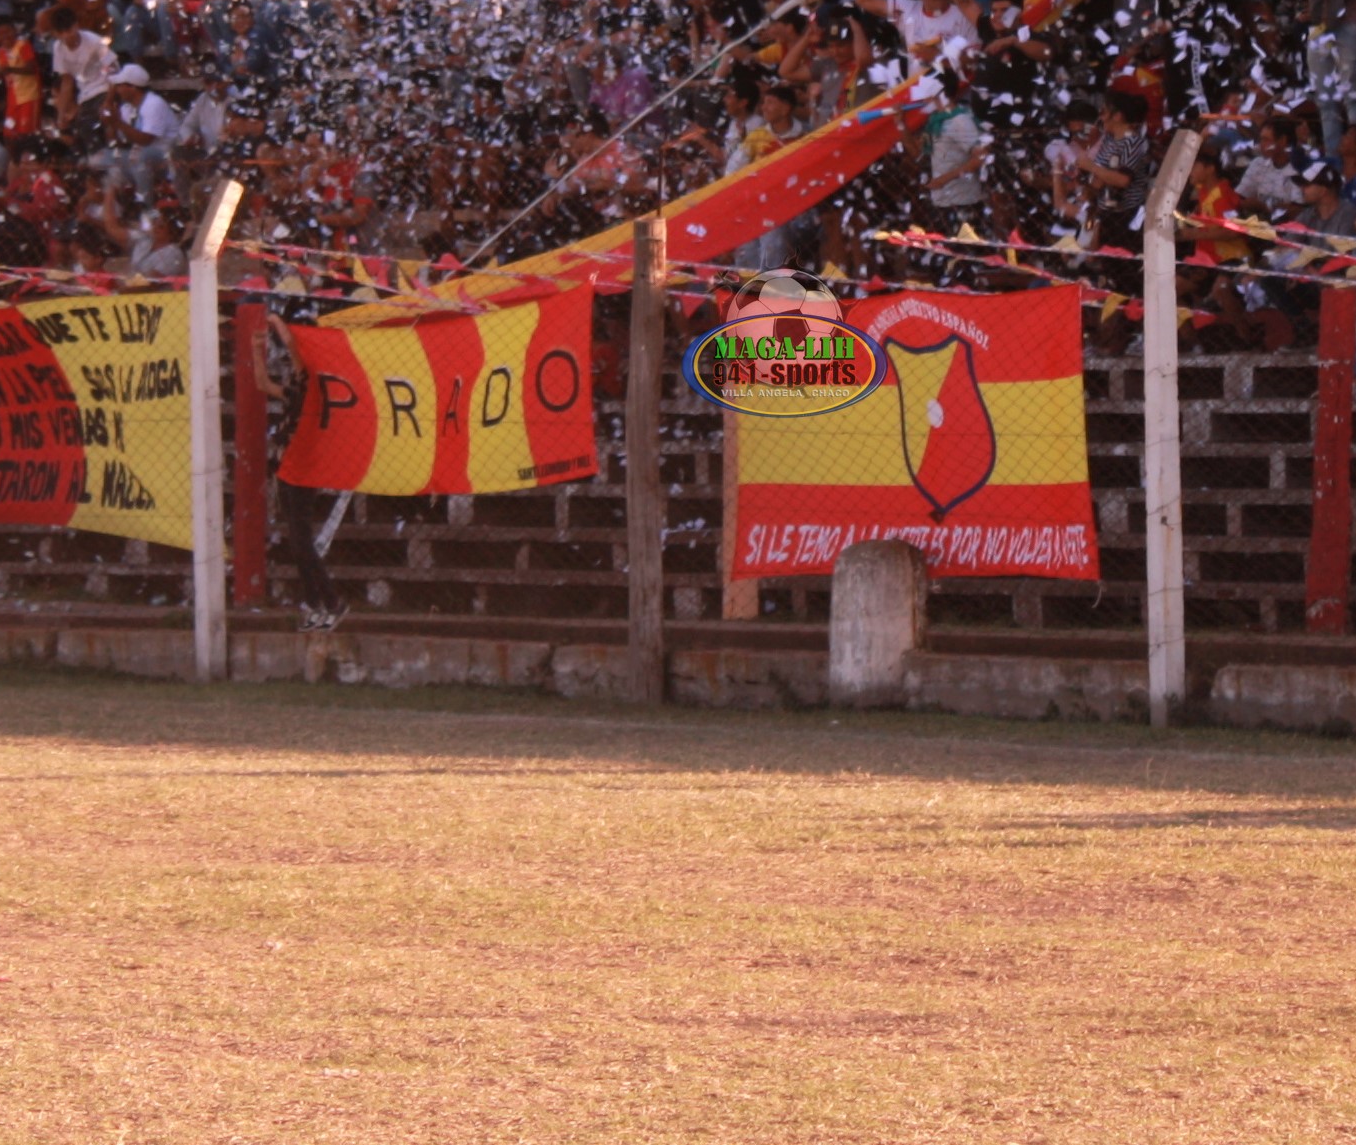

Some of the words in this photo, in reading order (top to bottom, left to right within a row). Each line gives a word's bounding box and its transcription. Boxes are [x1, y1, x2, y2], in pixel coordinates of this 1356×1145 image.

[68, 307, 110, 342] TE
[316, 349, 580, 438] PRADO
[11, 411, 43, 450] MIS
[66, 457, 92, 503] AL
[745, 524, 767, 566] SI
[766, 524, 795, 564] LE
[792, 524, 842, 566] TEMO
[946, 525, 982, 569] POR
[981, 526, 1007, 566] NO
